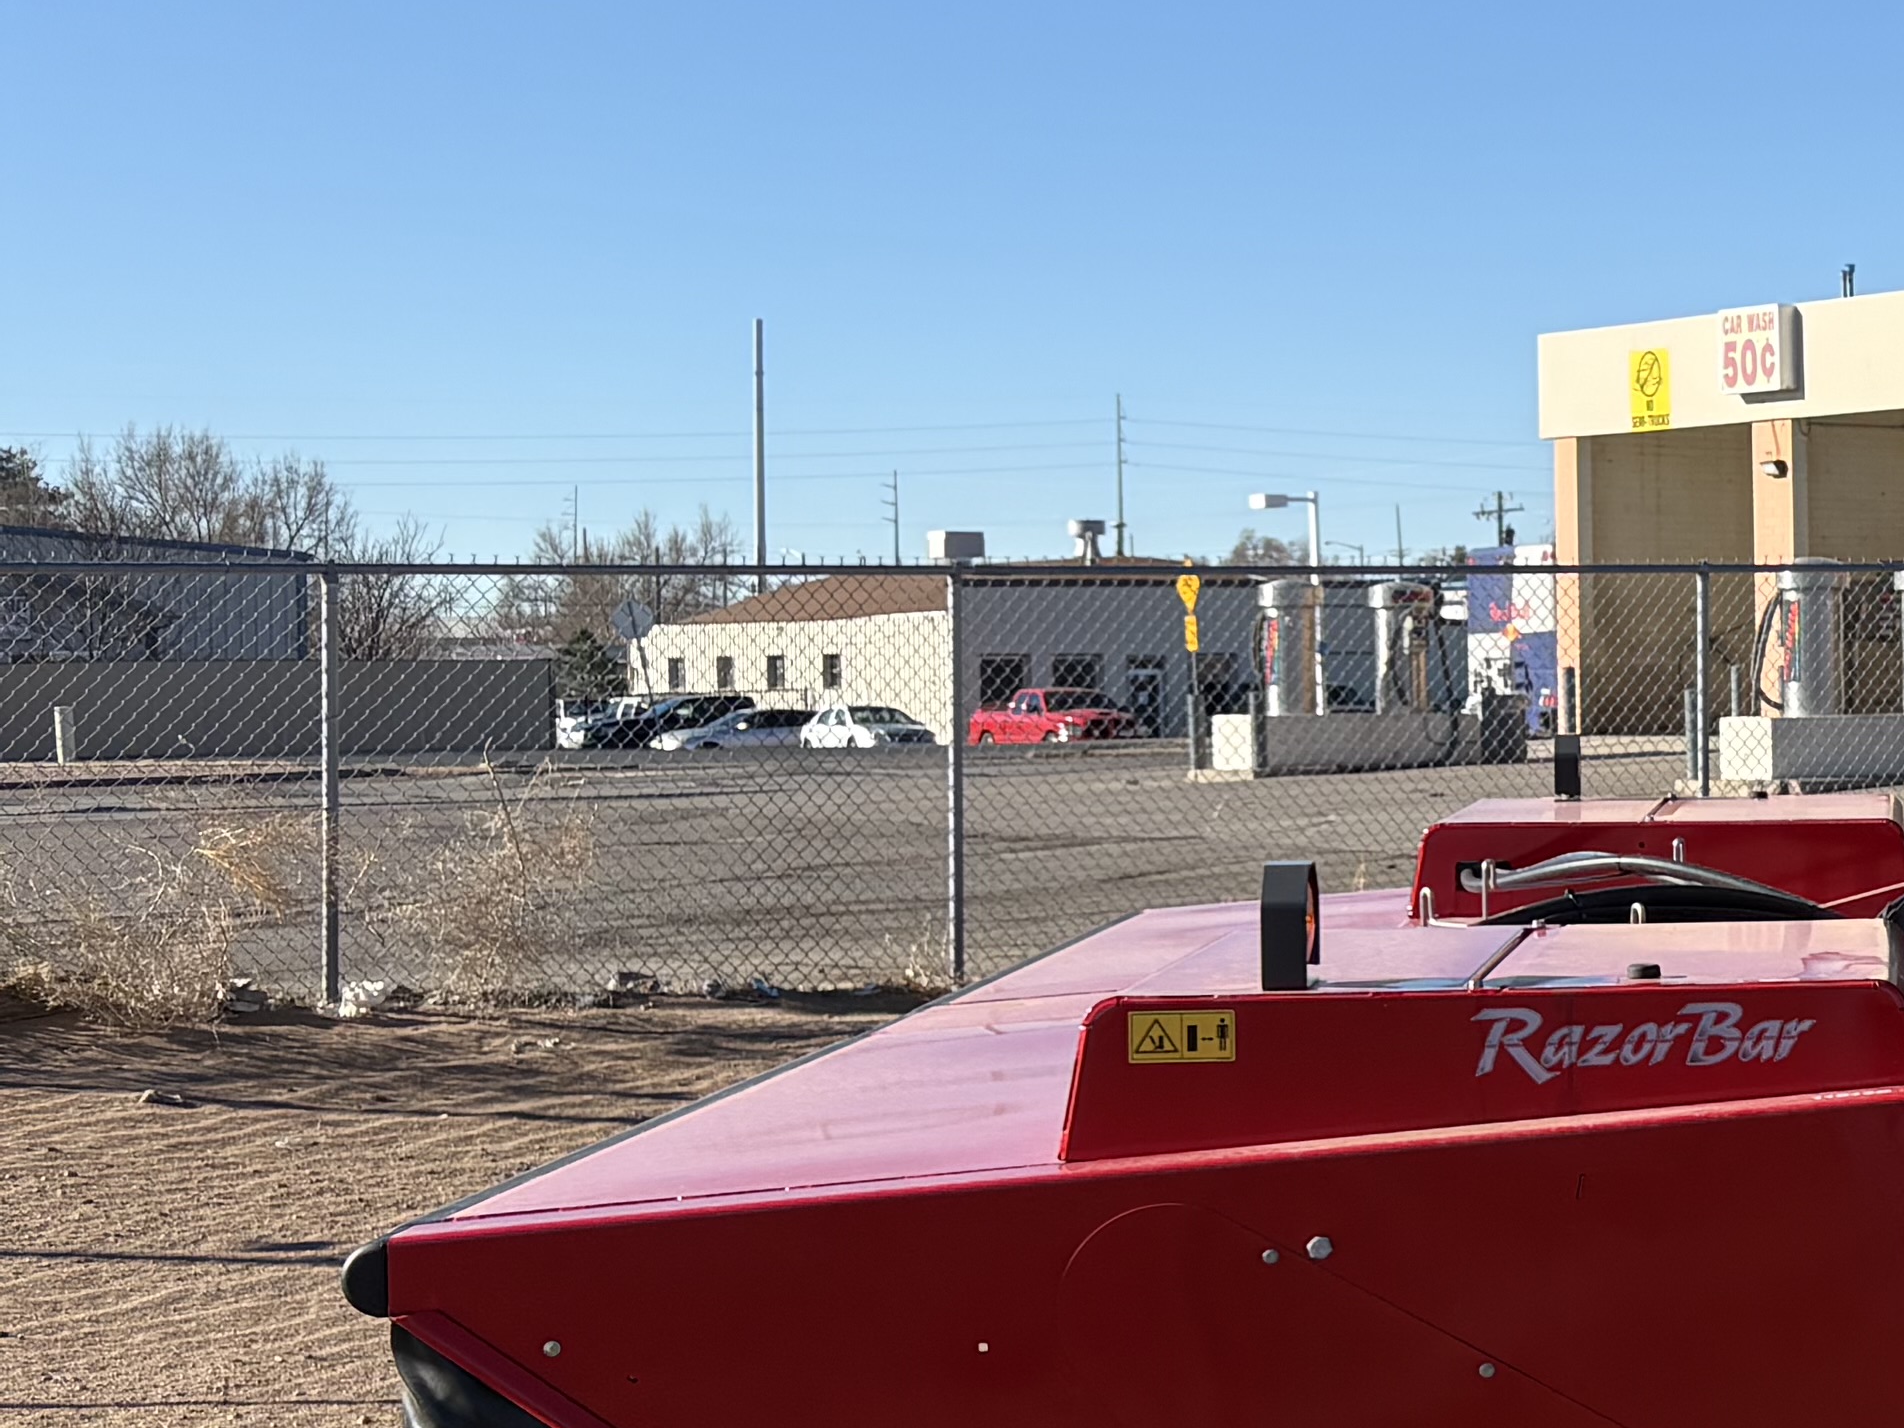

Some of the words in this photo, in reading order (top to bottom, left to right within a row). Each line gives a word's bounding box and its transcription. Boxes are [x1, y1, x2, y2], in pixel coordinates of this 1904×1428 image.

[1722, 315, 1742, 335] CAR
[1747, 312, 1774, 333] WASH
[1470, 1002, 1817, 1084] RazorBar
